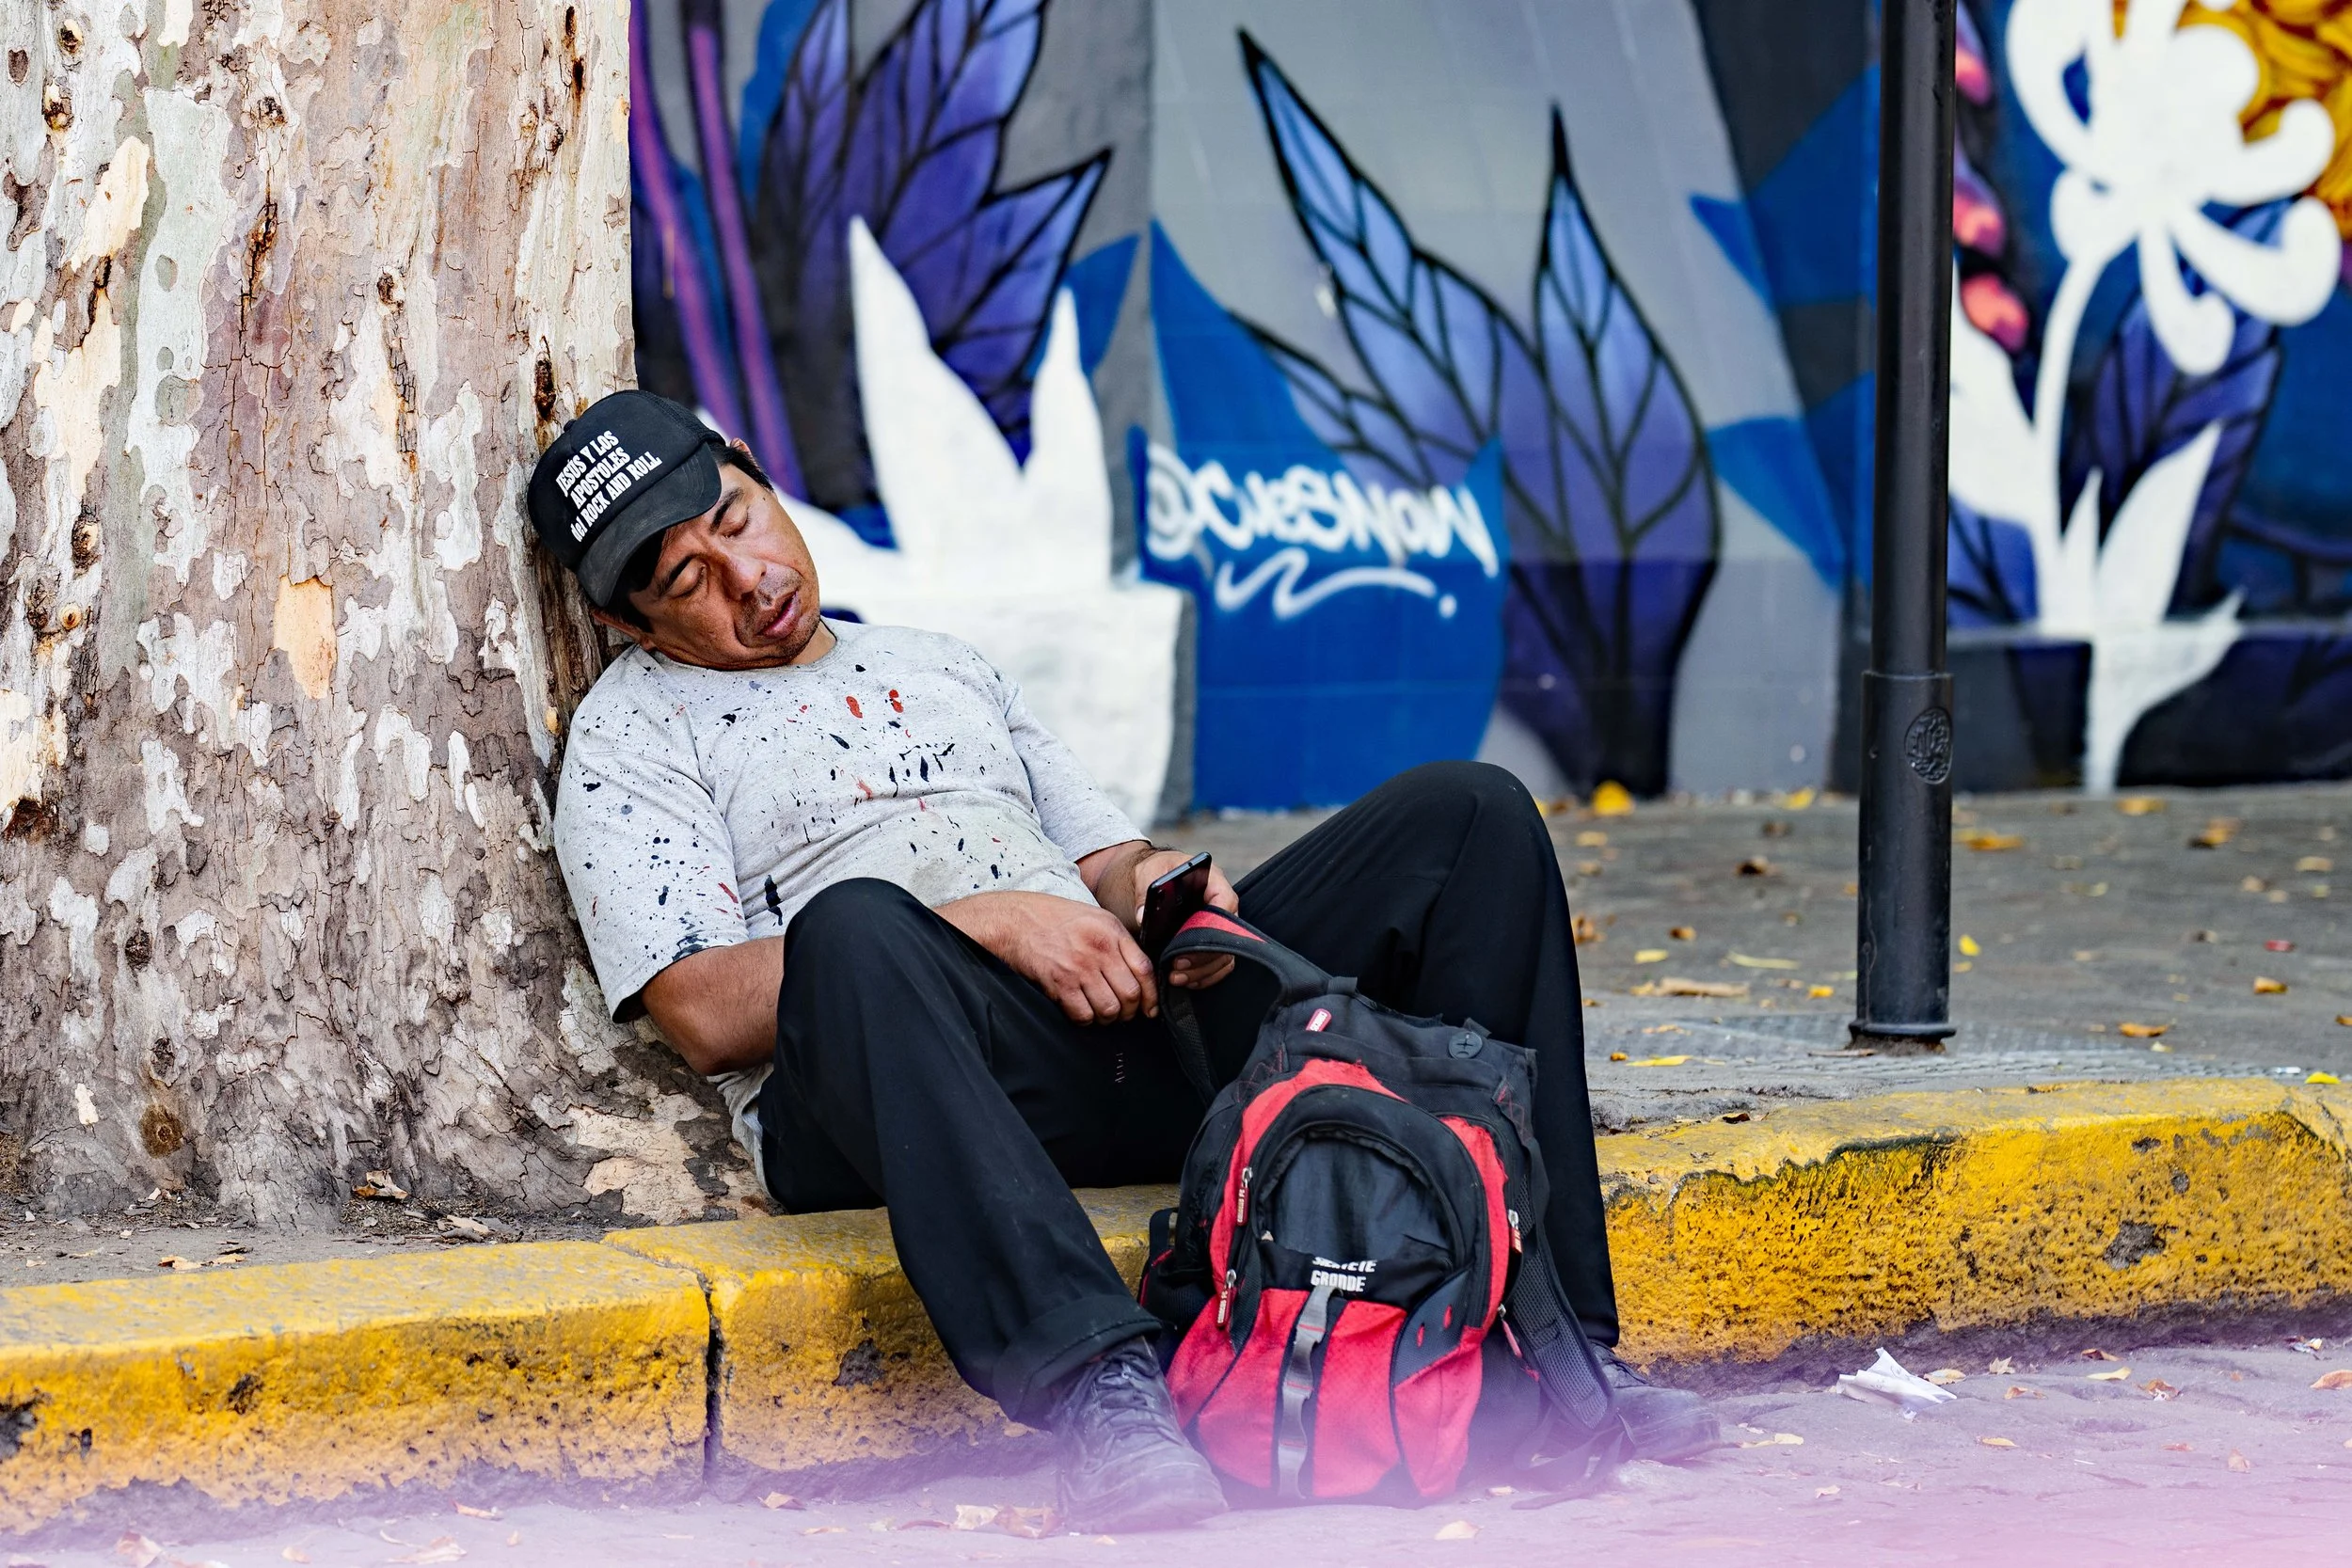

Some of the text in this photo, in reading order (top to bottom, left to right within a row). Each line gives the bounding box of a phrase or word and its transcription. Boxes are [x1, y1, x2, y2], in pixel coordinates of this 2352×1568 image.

[570, 446, 631, 510] APOSTOLES
[580, 447, 596, 464] Y
[589, 430, 620, 457] LOS
[570, 451, 662, 543] del ROCK AND ROLL
